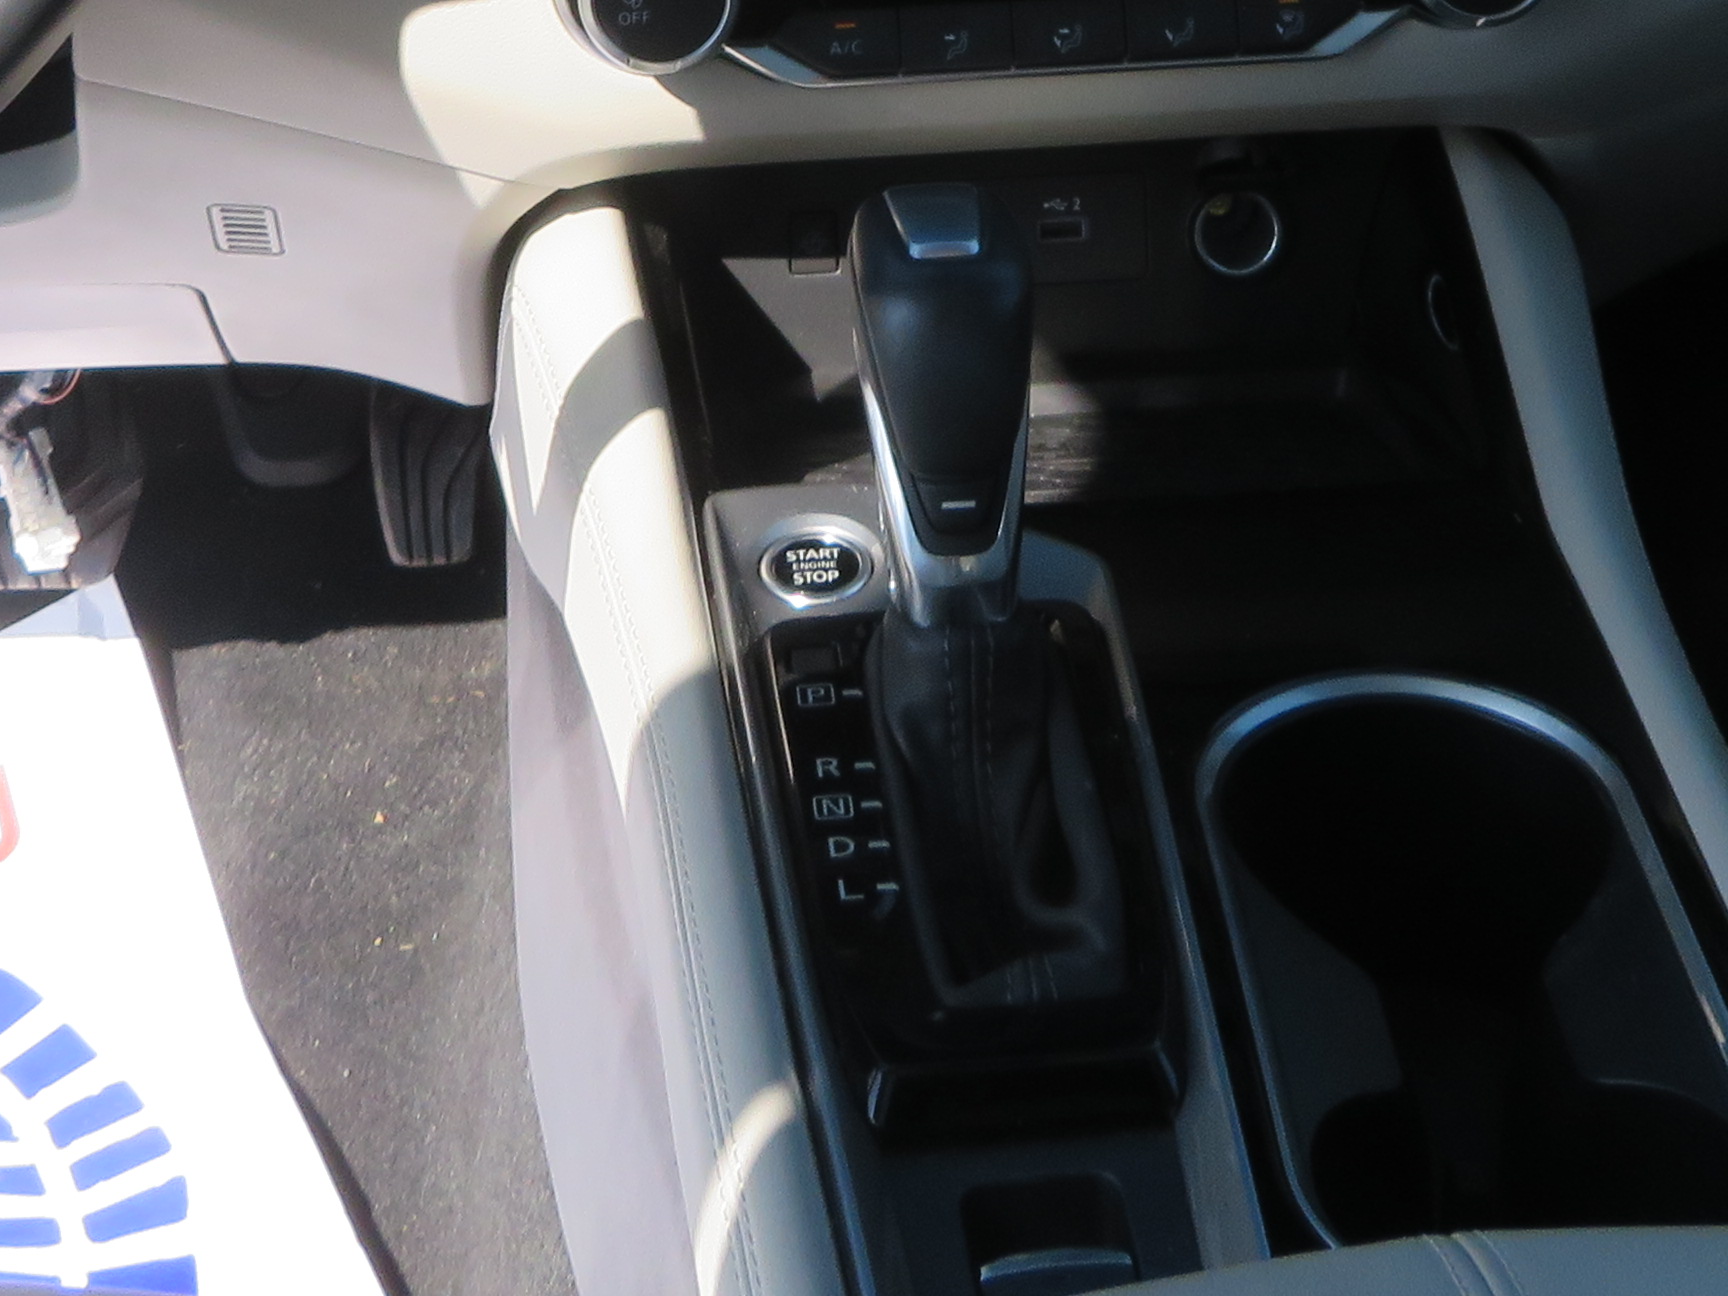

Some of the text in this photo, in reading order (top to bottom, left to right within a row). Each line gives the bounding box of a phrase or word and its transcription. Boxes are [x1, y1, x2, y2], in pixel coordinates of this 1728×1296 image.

[618, 10, 651, 27] OFF
[830, 38, 864, 56] A/C
[1072, 196, 1081, 211] 2
[785, 548, 840, 563] START
[792, 559, 838, 571] ENGINE
[792, 569, 840, 586] STOP
[815, 757, 841, 778] R
[823, 796, 845, 816] N
[827, 835, 856, 858] D
[838, 878, 865, 901] L
